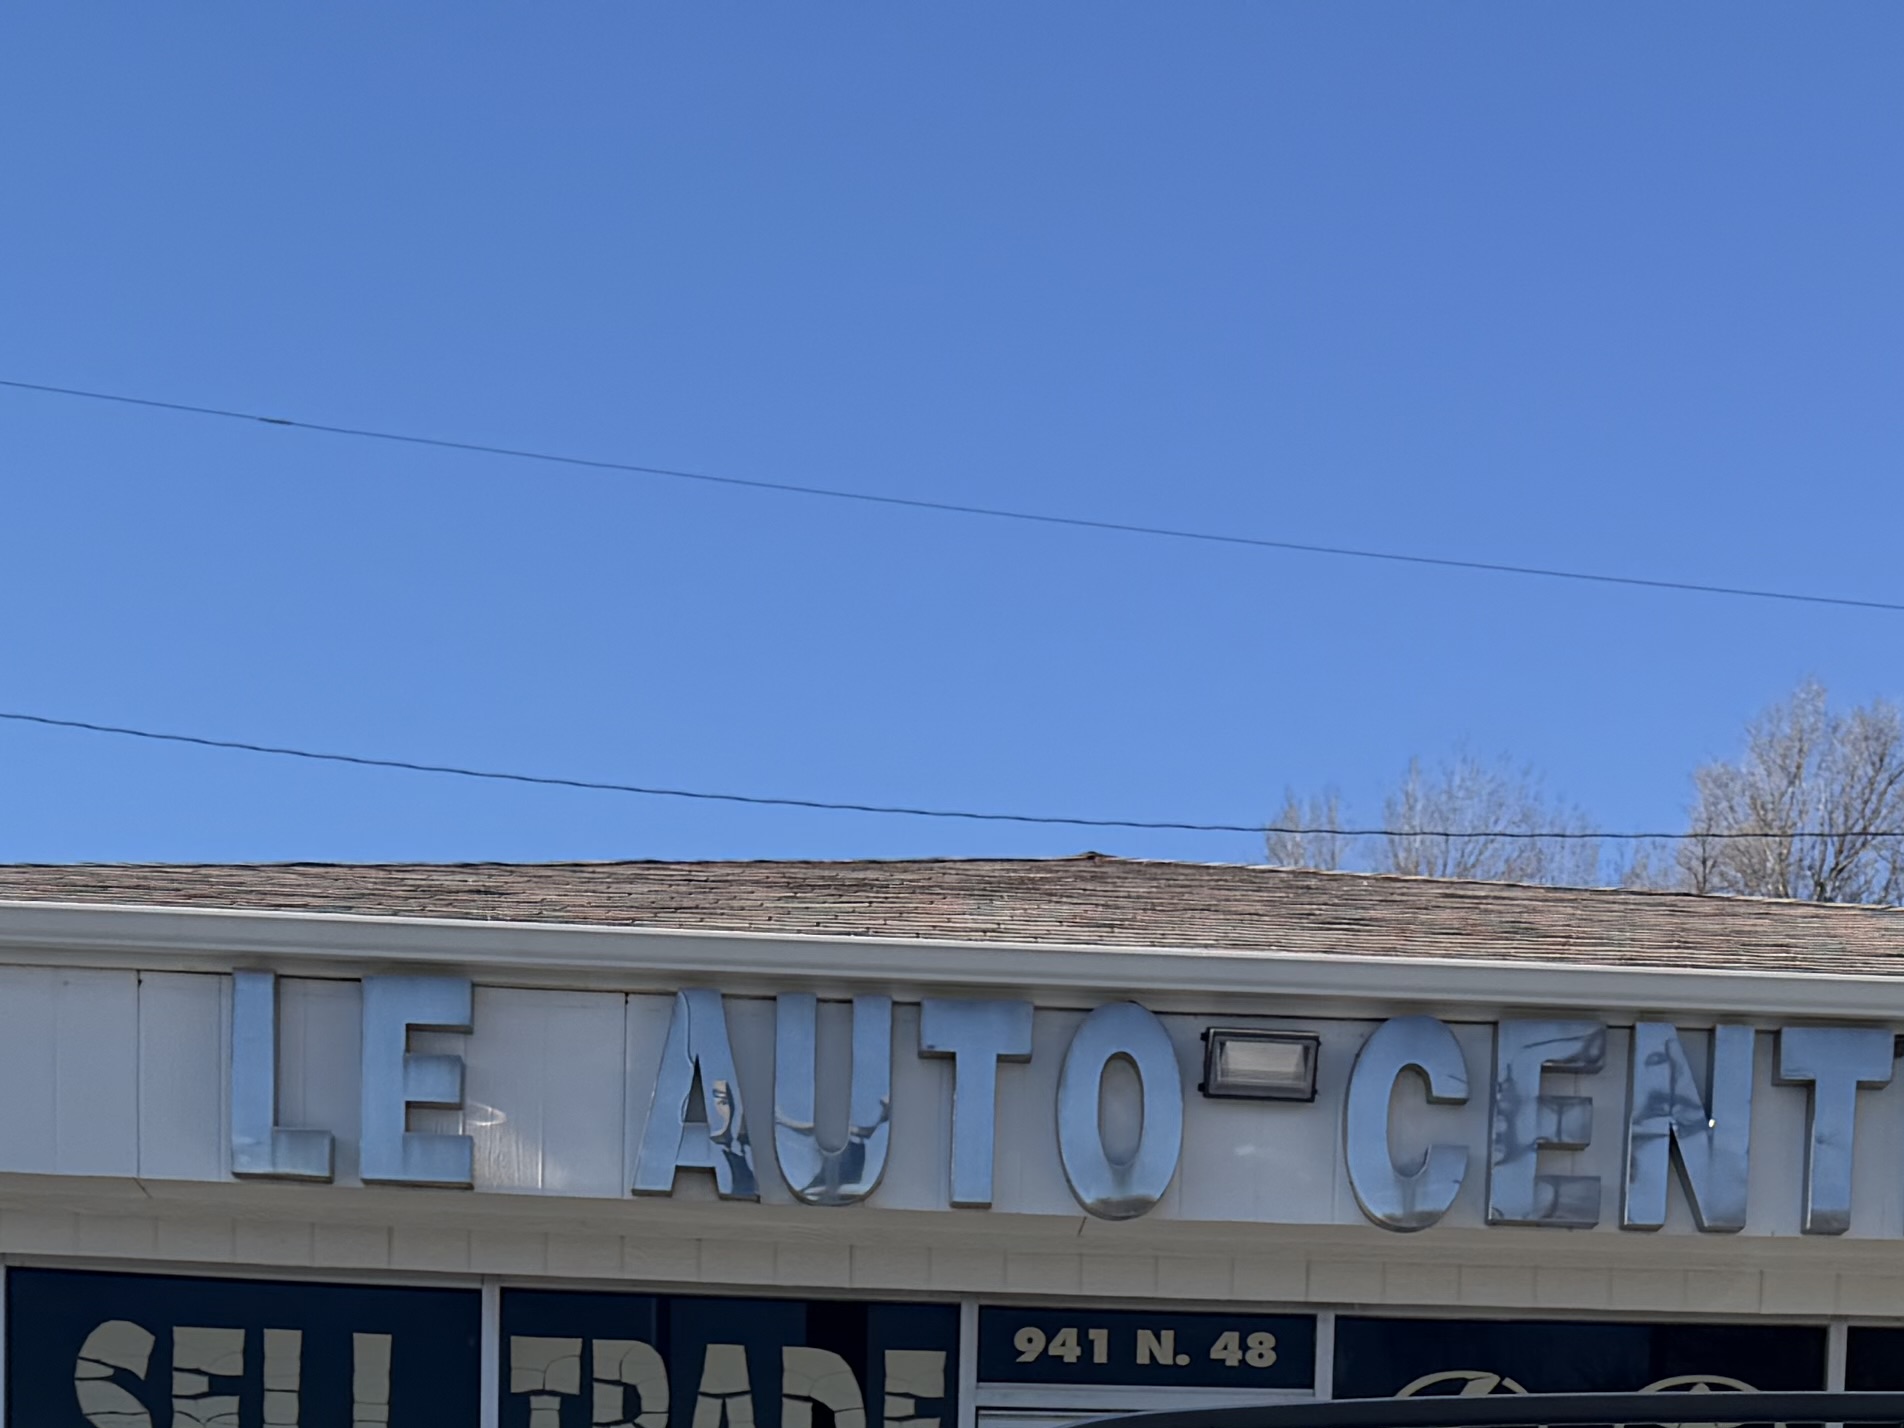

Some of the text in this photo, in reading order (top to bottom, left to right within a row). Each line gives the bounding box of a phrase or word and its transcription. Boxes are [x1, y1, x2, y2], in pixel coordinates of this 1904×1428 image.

[232, 968, 474, 1190] LE
[631, 986, 1183, 1221] AUTO
[1013, 1326, 1277, 1368] 941 N. 48
